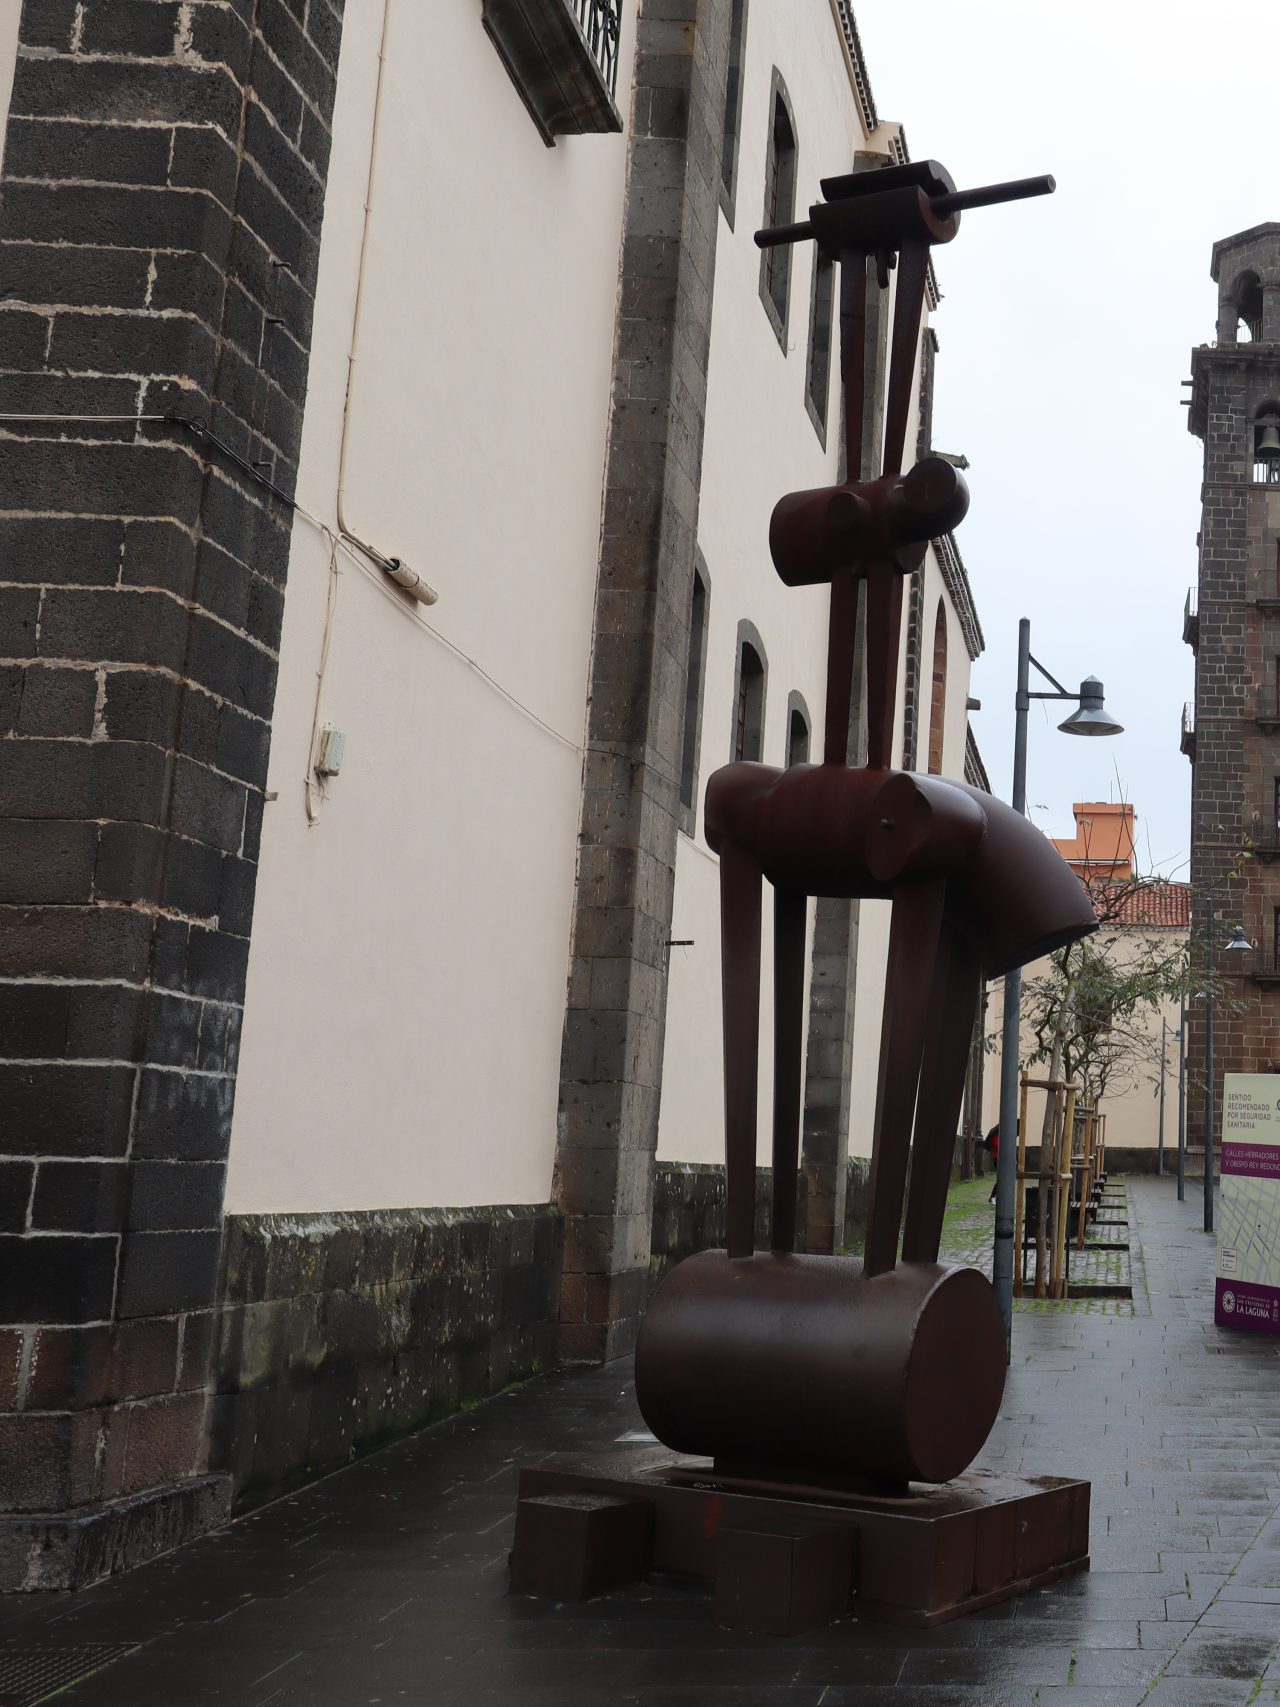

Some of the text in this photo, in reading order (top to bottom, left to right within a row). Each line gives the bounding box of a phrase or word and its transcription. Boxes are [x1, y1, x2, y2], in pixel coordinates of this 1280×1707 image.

[1245, 1152, 1279, 1160] HERRADORES
[1237, 1305, 1270, 1319] LA LAGUNA
